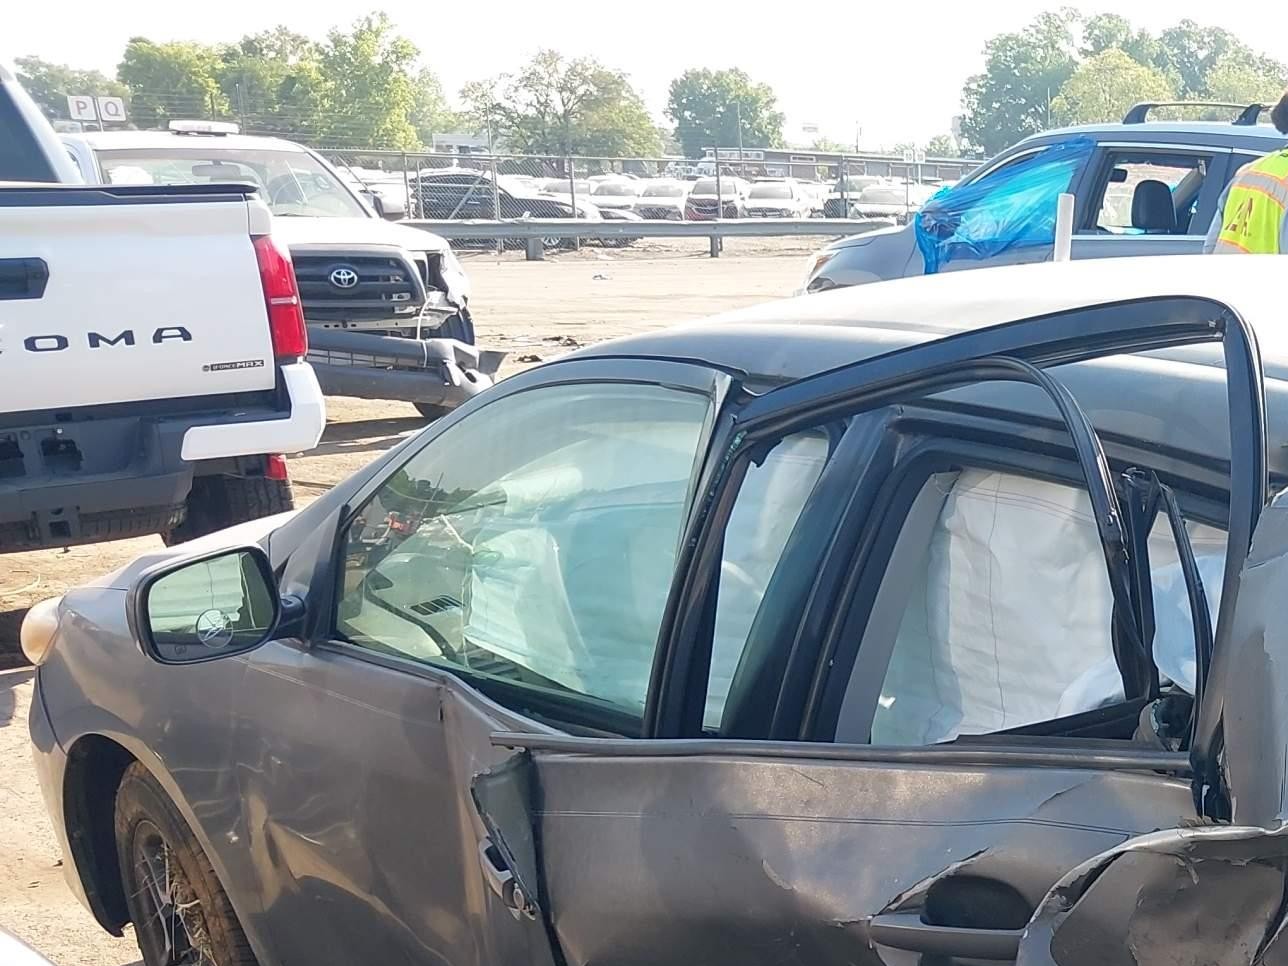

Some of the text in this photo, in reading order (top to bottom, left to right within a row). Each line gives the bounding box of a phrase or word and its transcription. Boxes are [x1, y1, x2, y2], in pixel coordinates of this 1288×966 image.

[75, 100, 87, 115] P
[104, 101, 121, 116] Q
[0, 326, 193, 354] OMA
